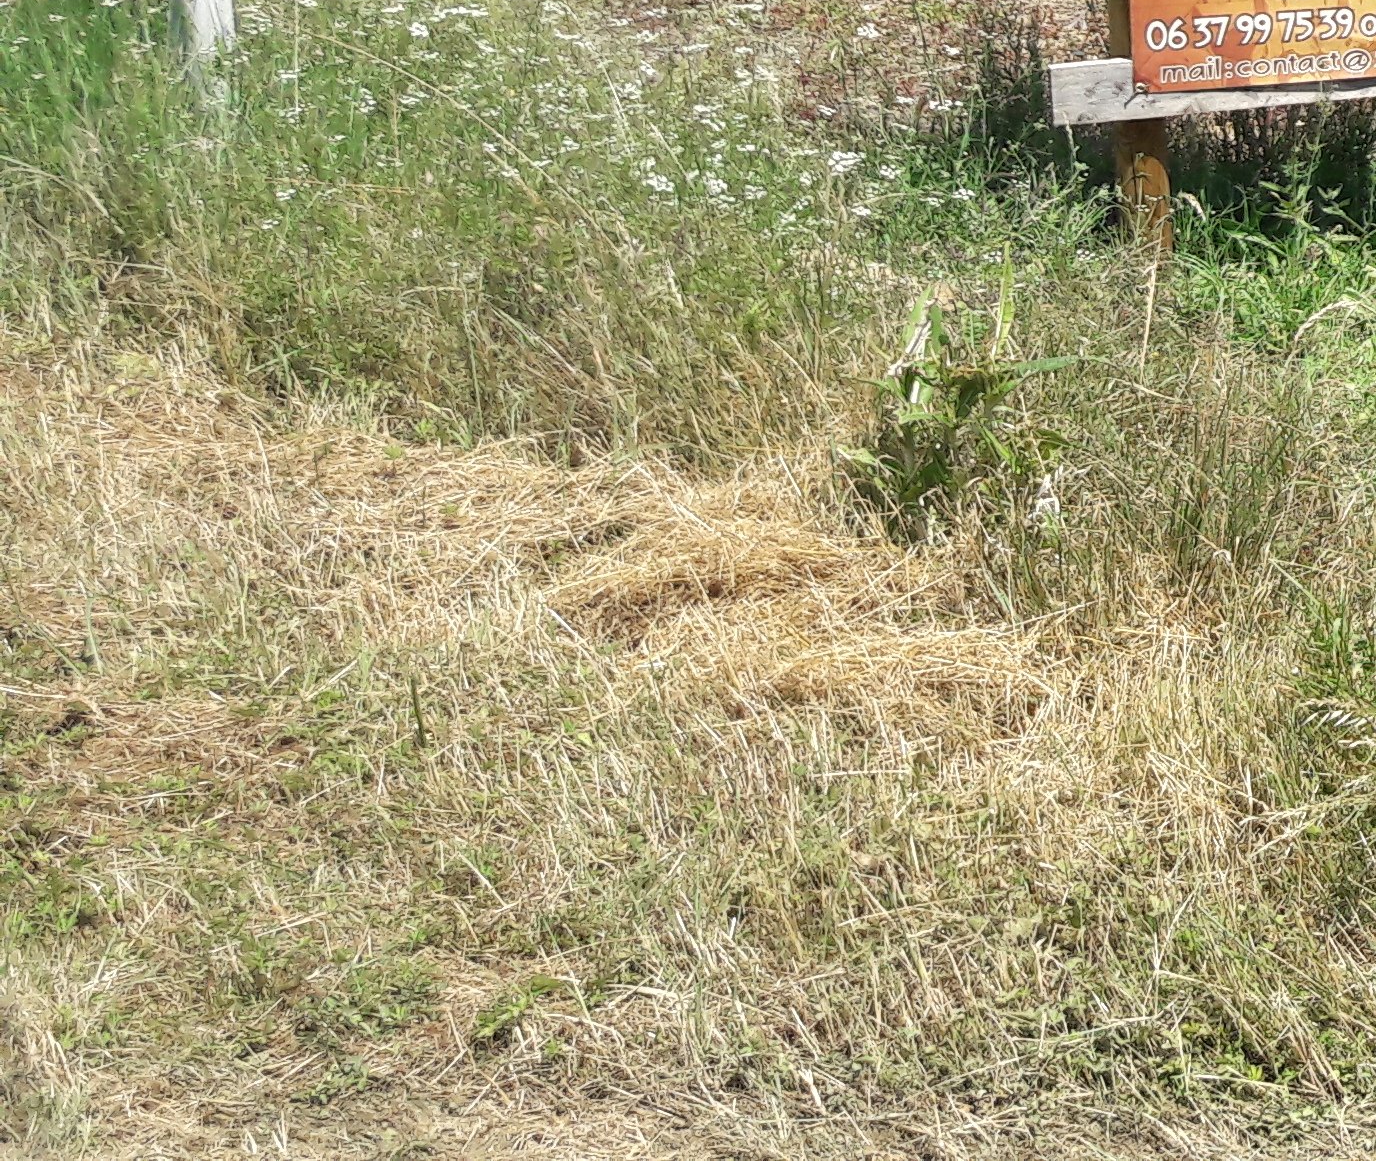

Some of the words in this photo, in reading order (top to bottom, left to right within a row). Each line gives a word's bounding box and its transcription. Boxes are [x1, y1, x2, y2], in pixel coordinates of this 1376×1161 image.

[1144, 17, 1189, 52] 06
[1192, 15, 1231, 49] 37
[1233, 11, 1274, 45] 99
[1275, 8, 1315, 42] 75
[1316, 6, 1355, 40] 39
